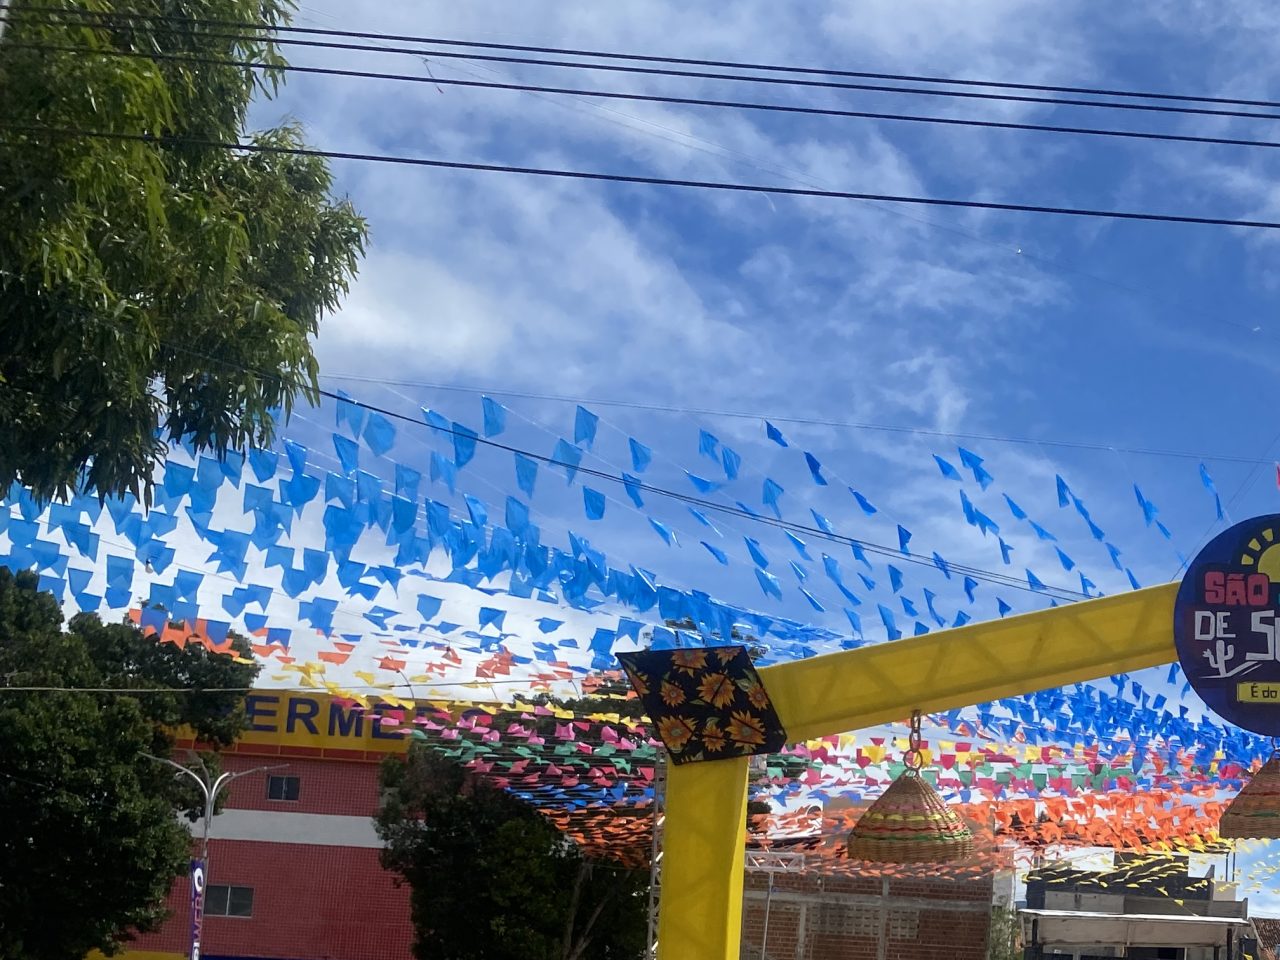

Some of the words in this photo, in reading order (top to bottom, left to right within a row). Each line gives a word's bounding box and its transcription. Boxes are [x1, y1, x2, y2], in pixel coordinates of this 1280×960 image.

[1204, 571, 1269, 606] SÃO
[1194, 610, 1236, 641] DE
[1250, 683, 1259, 699] É
[1262, 686, 1278, 699] do
